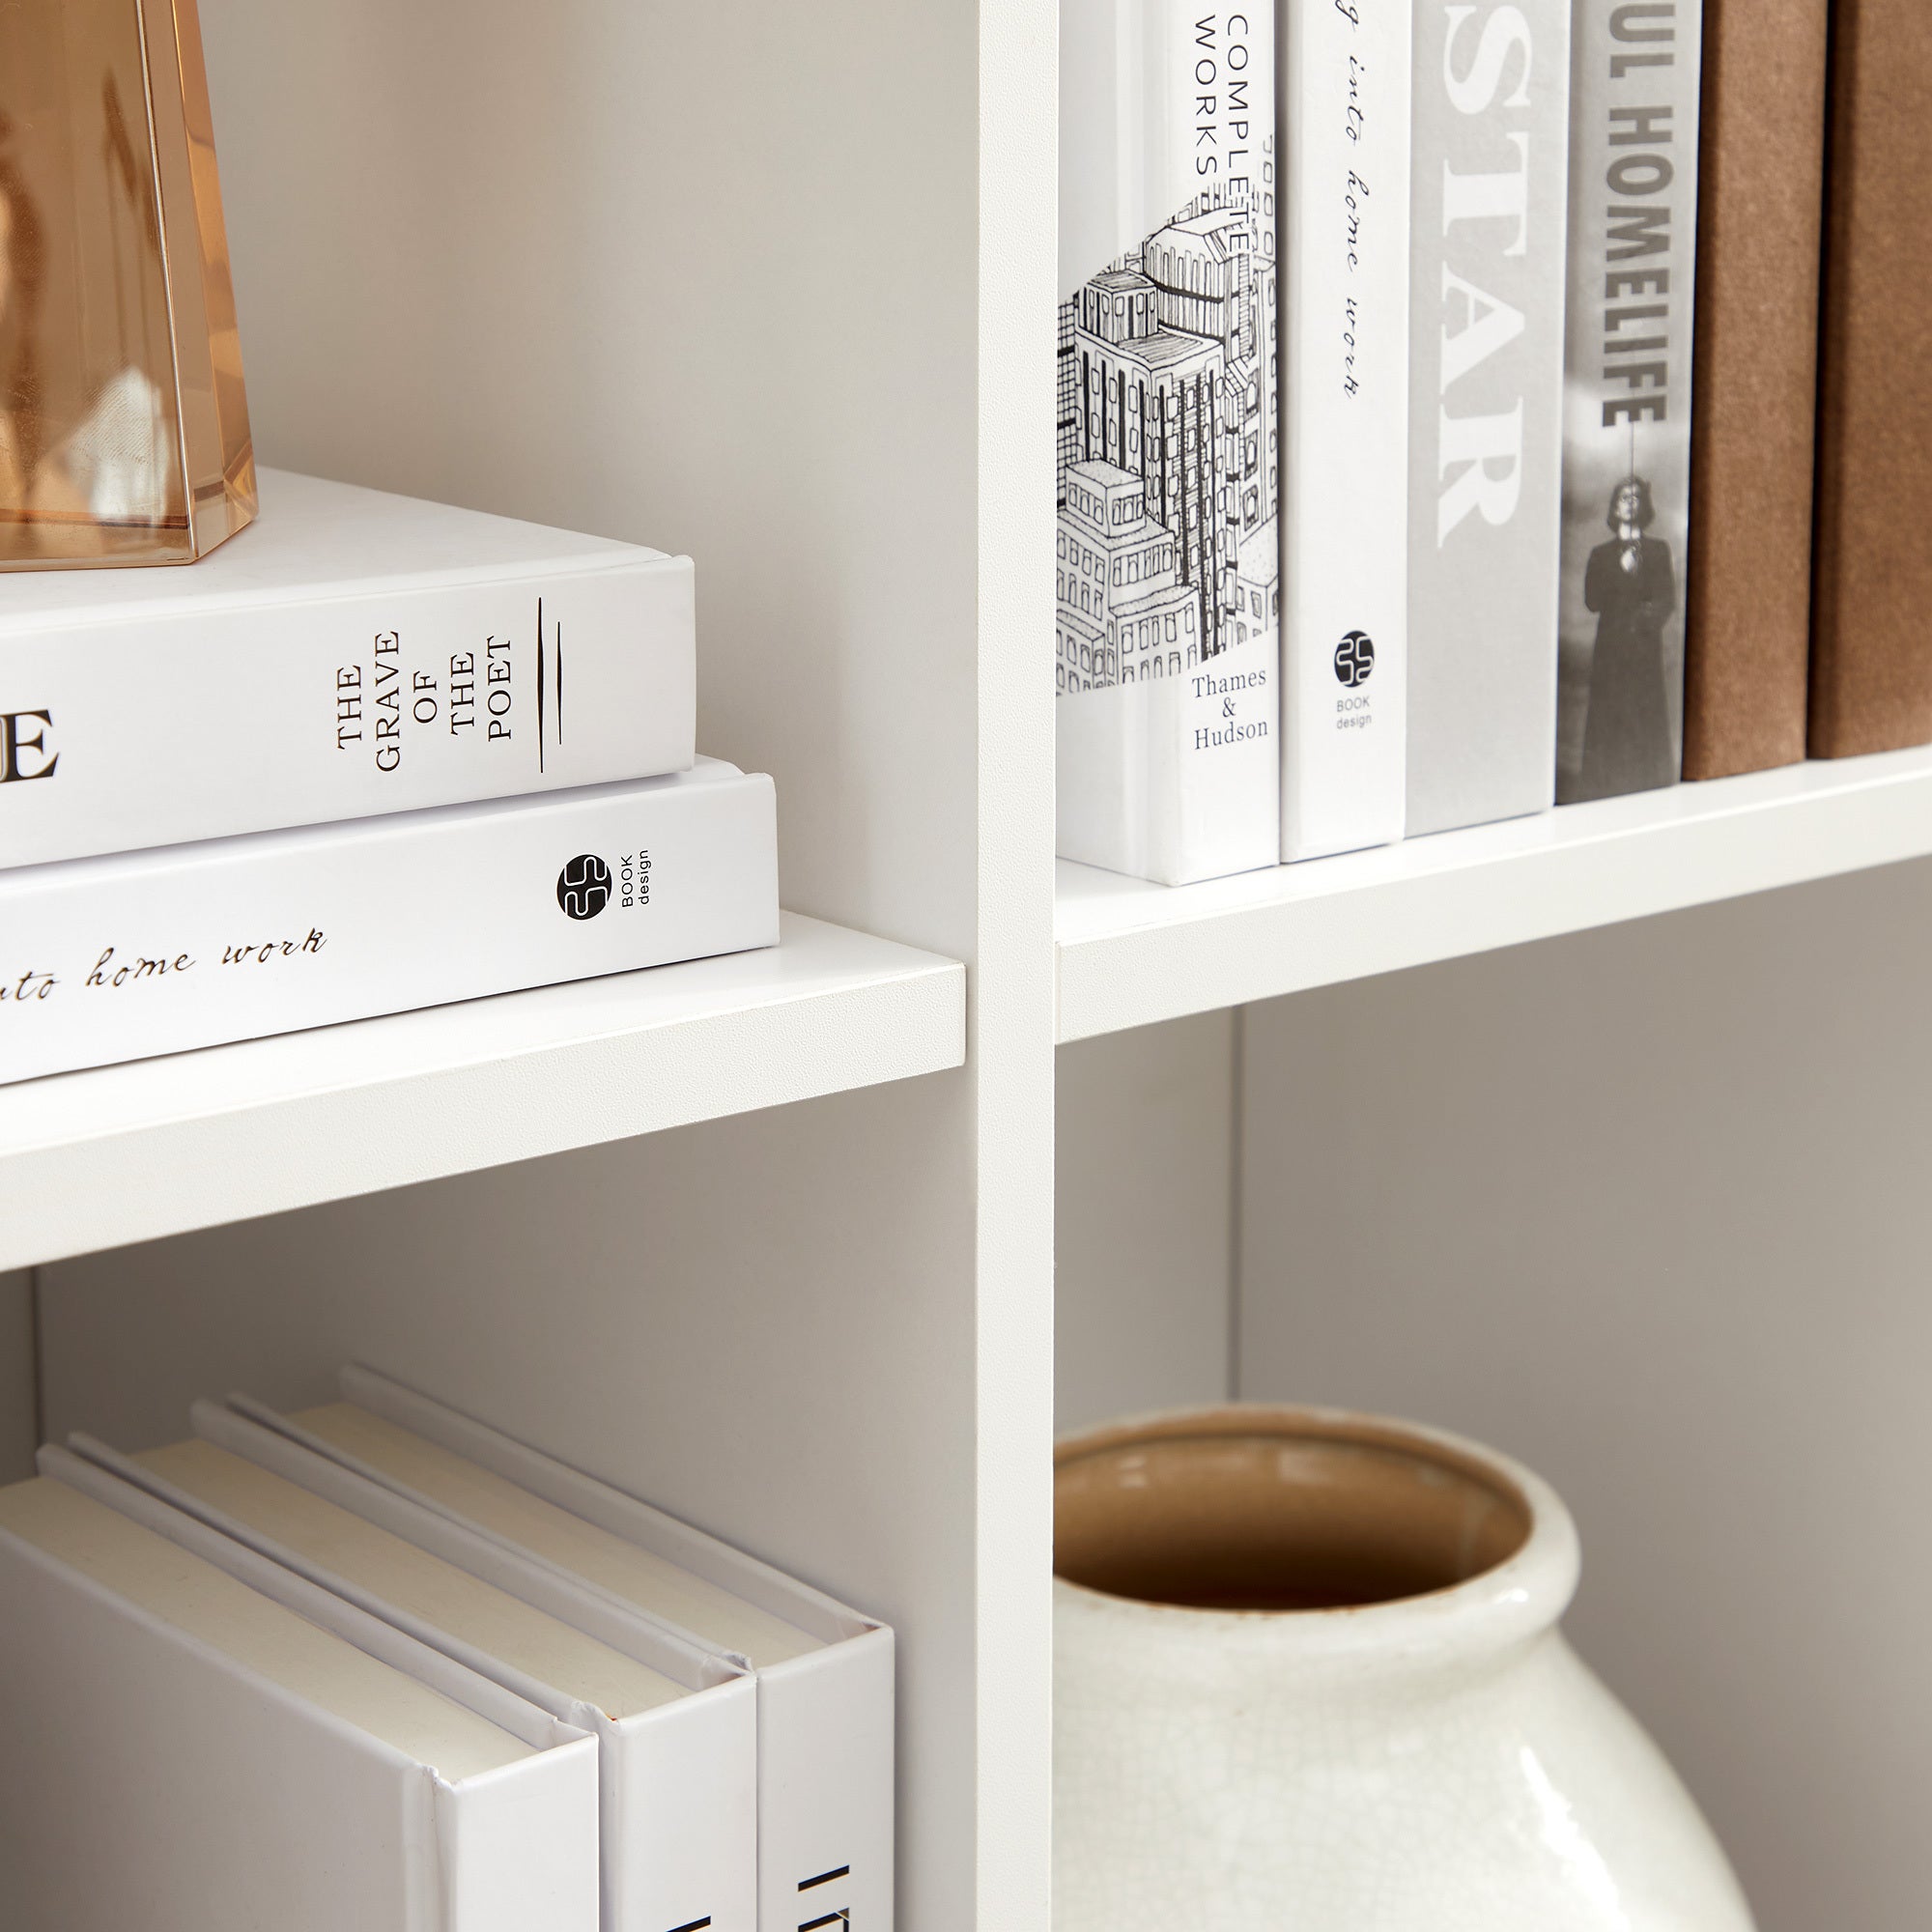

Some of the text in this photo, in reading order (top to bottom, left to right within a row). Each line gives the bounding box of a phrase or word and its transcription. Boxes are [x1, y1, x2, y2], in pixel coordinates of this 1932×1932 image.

[1195, 14, 1217, 176] WORKS
[1228, 14, 1250, 253] COMPLETE
[1346, 55, 1365, 146] into
[1344, 169, 1370, 272] home
[1602, 4, 1675, 428] UL HOMELIFE
[1437, 5, 1533, 549] STAR
[1343, 298, 1359, 399] work
[336, 665, 362, 750] THE
[374, 631, 400, 772] GRAVE
[412, 670, 438, 724] OF
[450, 652, 474, 736] THE
[486, 635, 511, 742] POET
[1192, 669, 1266, 697] Thames
[1222, 696, 1236, 718] &
[1337, 696, 1370, 713] BOOK
[1337, 714, 1372, 729] design
[0, 709, 60, 783] E
[1194, 720, 1268, 750] Hudson
[621, 854, 634, 908] BOOK
[638, 849, 651, 905] design
[85, 947, 196, 987] home
[221, 927, 327, 965] work
